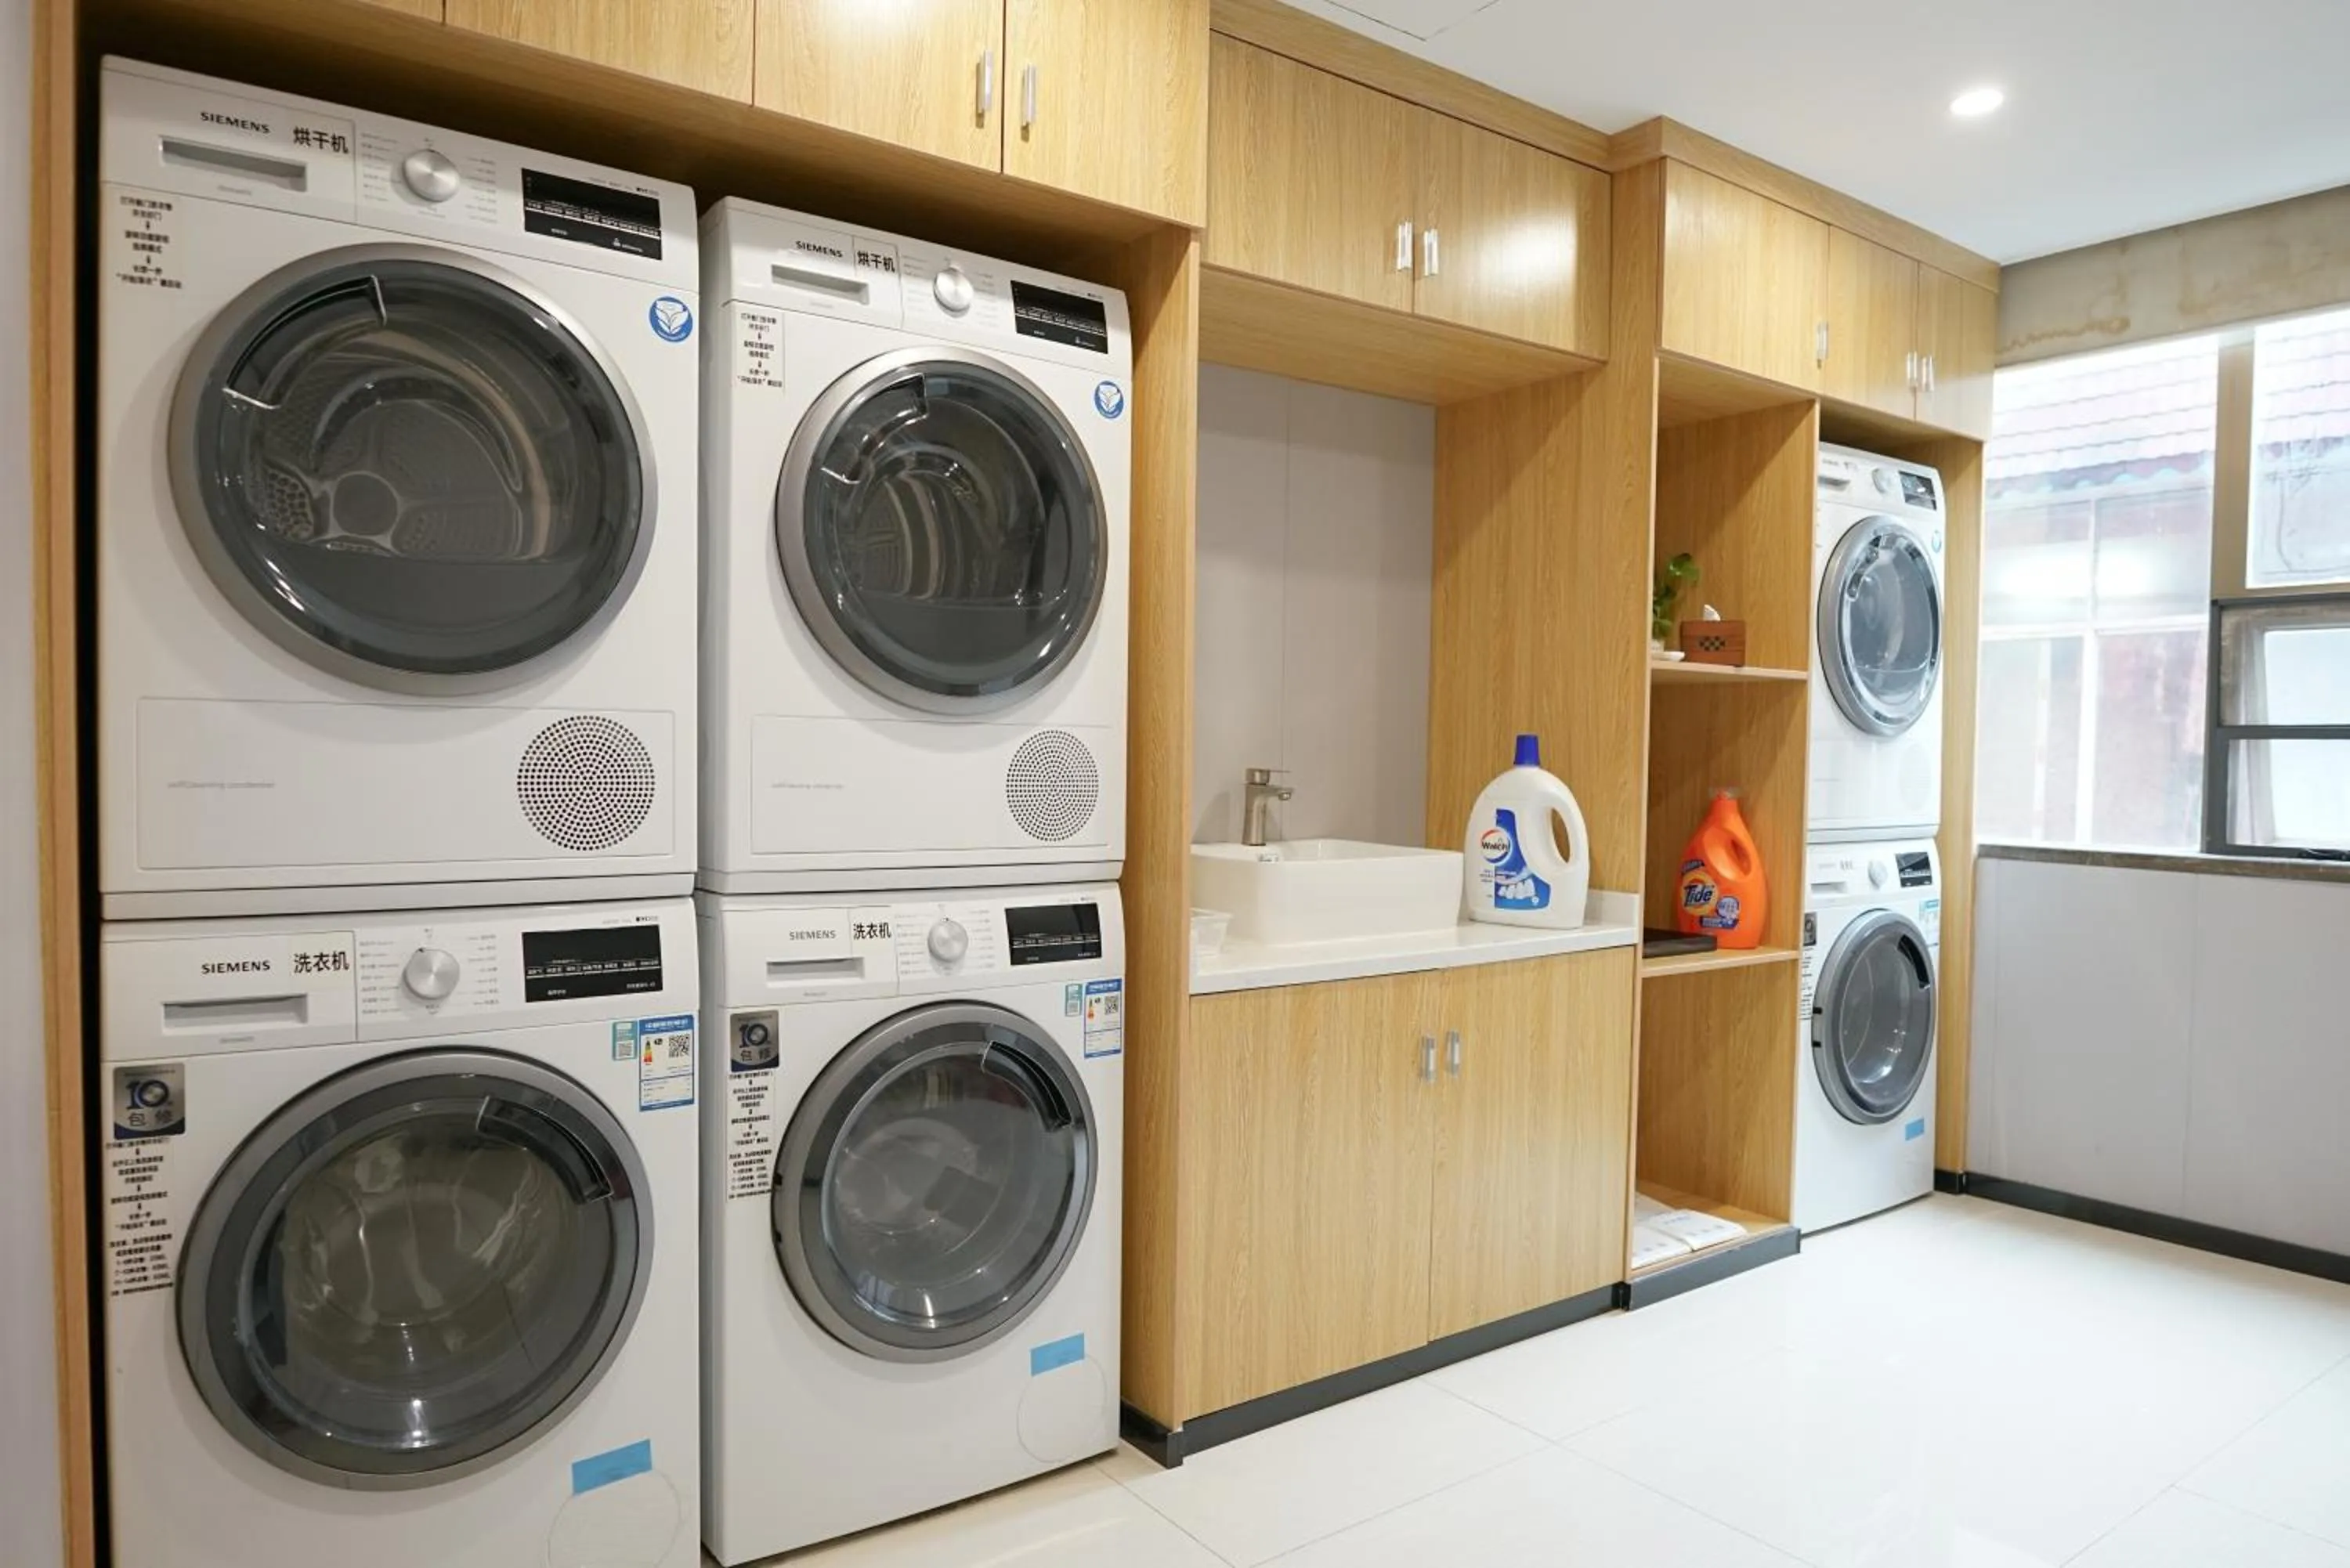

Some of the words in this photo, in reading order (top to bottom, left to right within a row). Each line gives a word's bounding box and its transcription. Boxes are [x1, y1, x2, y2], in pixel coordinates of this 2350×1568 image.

[200, 111, 270, 133] SIEMENS
[293, 126, 349, 154] 烘干机
[795, 240, 843, 258] SIEMENS
[857, 250, 895, 273] 烘干机
[1684, 884, 1715, 907] Tide
[789, 930, 836, 941] SIEMENS
[853, 922, 891, 940] 洗衣机
[201, 960, 271, 974] SIEMENS
[293, 951, 350, 974] 洗衣机
